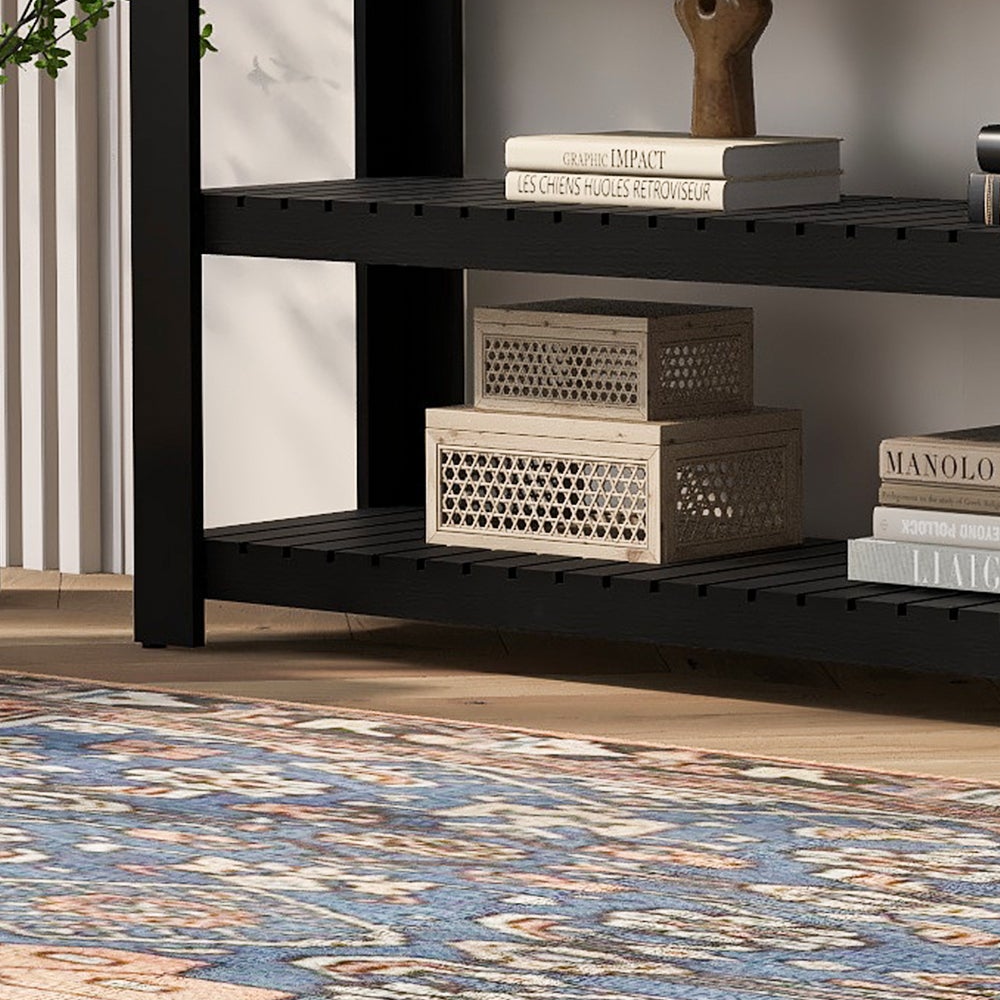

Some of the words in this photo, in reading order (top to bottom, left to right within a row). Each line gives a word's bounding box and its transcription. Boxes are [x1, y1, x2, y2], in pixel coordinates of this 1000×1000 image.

[562, 151, 609, 168] GRAPHIC
[611, 148, 666, 170] IMPACT
[517, 174, 537, 194] LES
[539, 175, 582, 196] CHIENS
[633, 179, 711, 202] RETROVISEUR
[886, 451, 994, 482] MANOLO
[901, 518, 957, 539] POLLOCK
